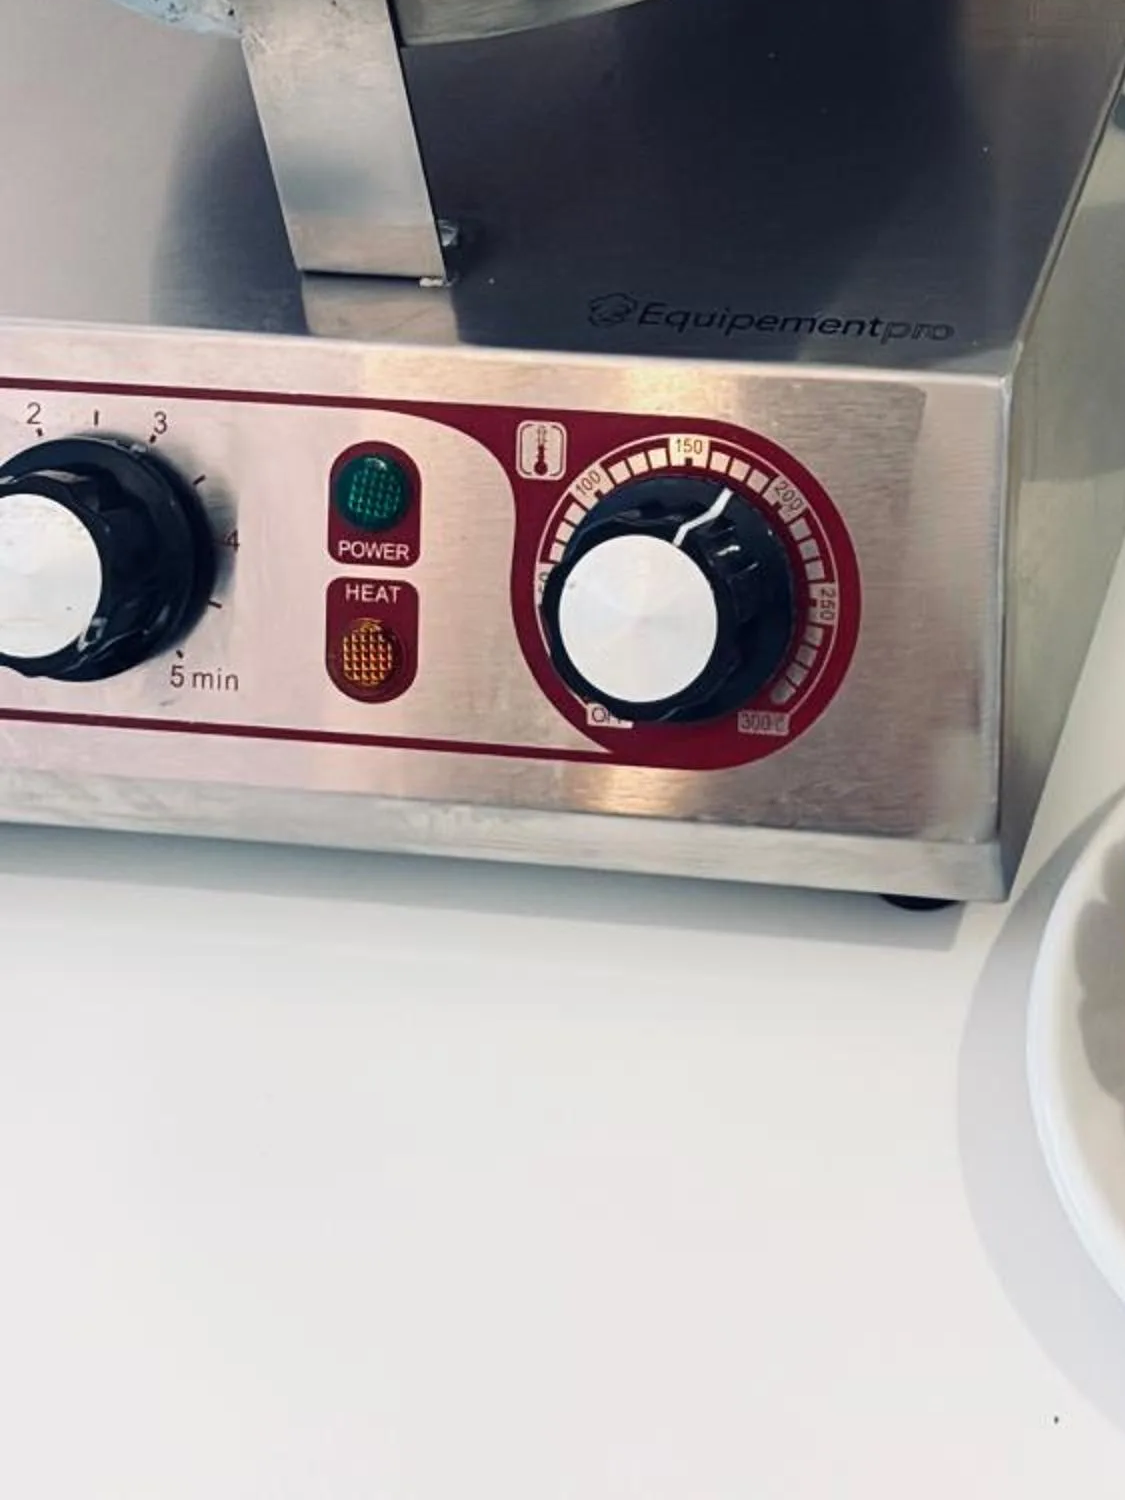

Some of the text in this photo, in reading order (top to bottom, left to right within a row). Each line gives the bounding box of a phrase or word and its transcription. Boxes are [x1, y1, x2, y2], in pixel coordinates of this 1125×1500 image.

[637, 302, 956, 344] Equipementpro
[26, 402, 42, 425] 2
[153, 411, 168, 435] 3
[675, 439, 704, 455] 150
[575, 471, 602, 498] 100
[773, 480, 803, 511] 200
[223, 529, 240, 552] 4
[338, 540, 410, 562] POWER
[345, 583, 402, 605] HEAT
[820, 586, 836, 621] 250
[170, 666, 239, 691] 5 min
